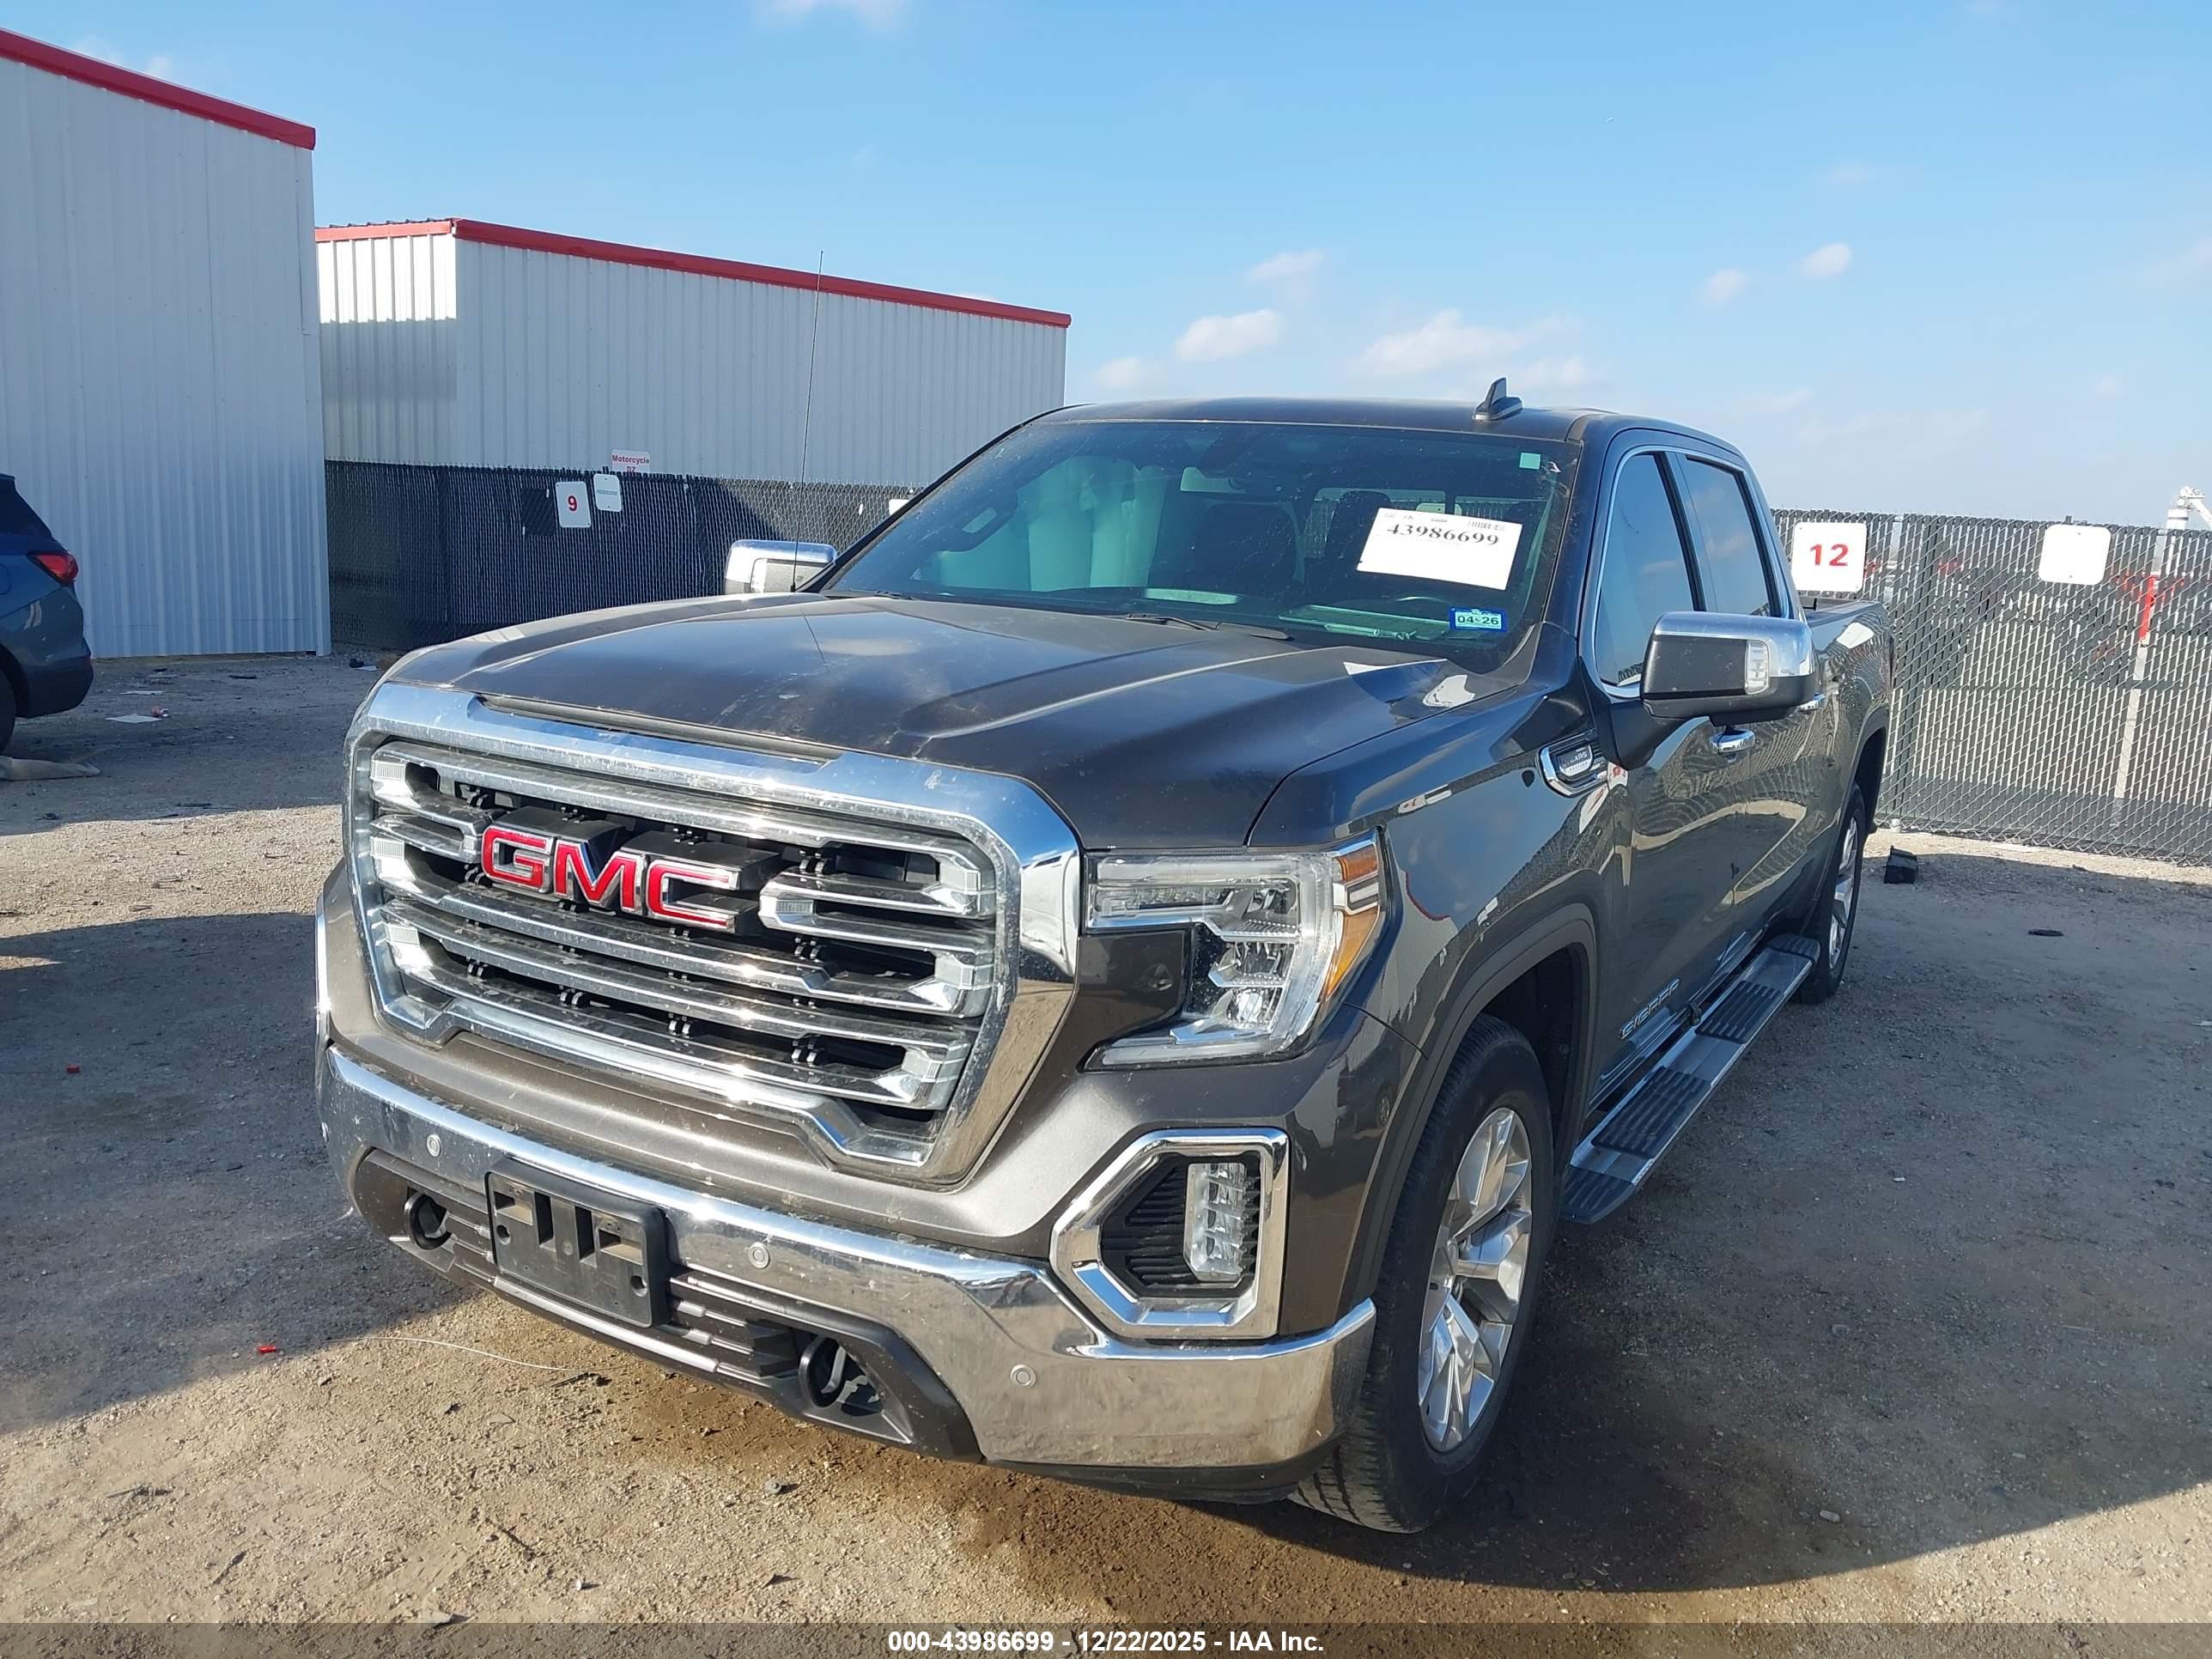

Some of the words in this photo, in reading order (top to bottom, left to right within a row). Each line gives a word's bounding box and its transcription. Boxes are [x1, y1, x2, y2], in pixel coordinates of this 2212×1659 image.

[611, 454, 650, 465] Motorcycle
[568, 495, 578, 512] 9
[1387, 523, 1499, 546] 43986699
[1809, 543, 1850, 567] 12
[482, 824, 742, 935] GMC
